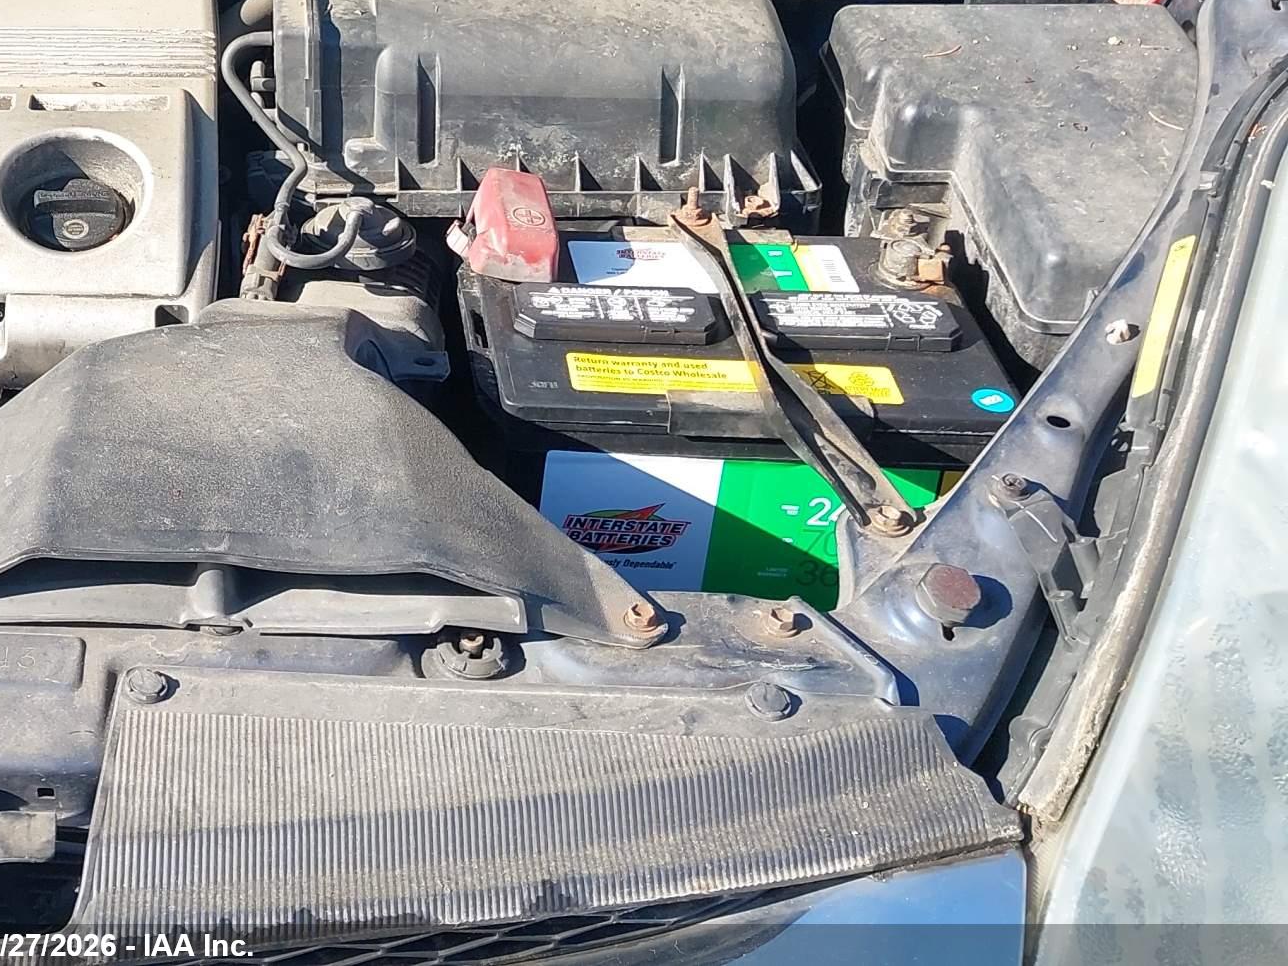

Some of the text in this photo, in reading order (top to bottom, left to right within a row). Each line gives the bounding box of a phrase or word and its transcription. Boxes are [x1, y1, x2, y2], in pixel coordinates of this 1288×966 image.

[573, 356, 609, 365] Return
[611, 360, 658, 369] warranty
[661, 361, 680, 369] and
[576, 365, 621, 375] batteries
[637, 368, 670, 377] Costco
[673, 370, 727, 379] Wholesale
[565, 516, 686, 534] INTERSTATE
[569, 530, 674, 546] BATTERIES
[623, 559, 673, 570] Dependable
